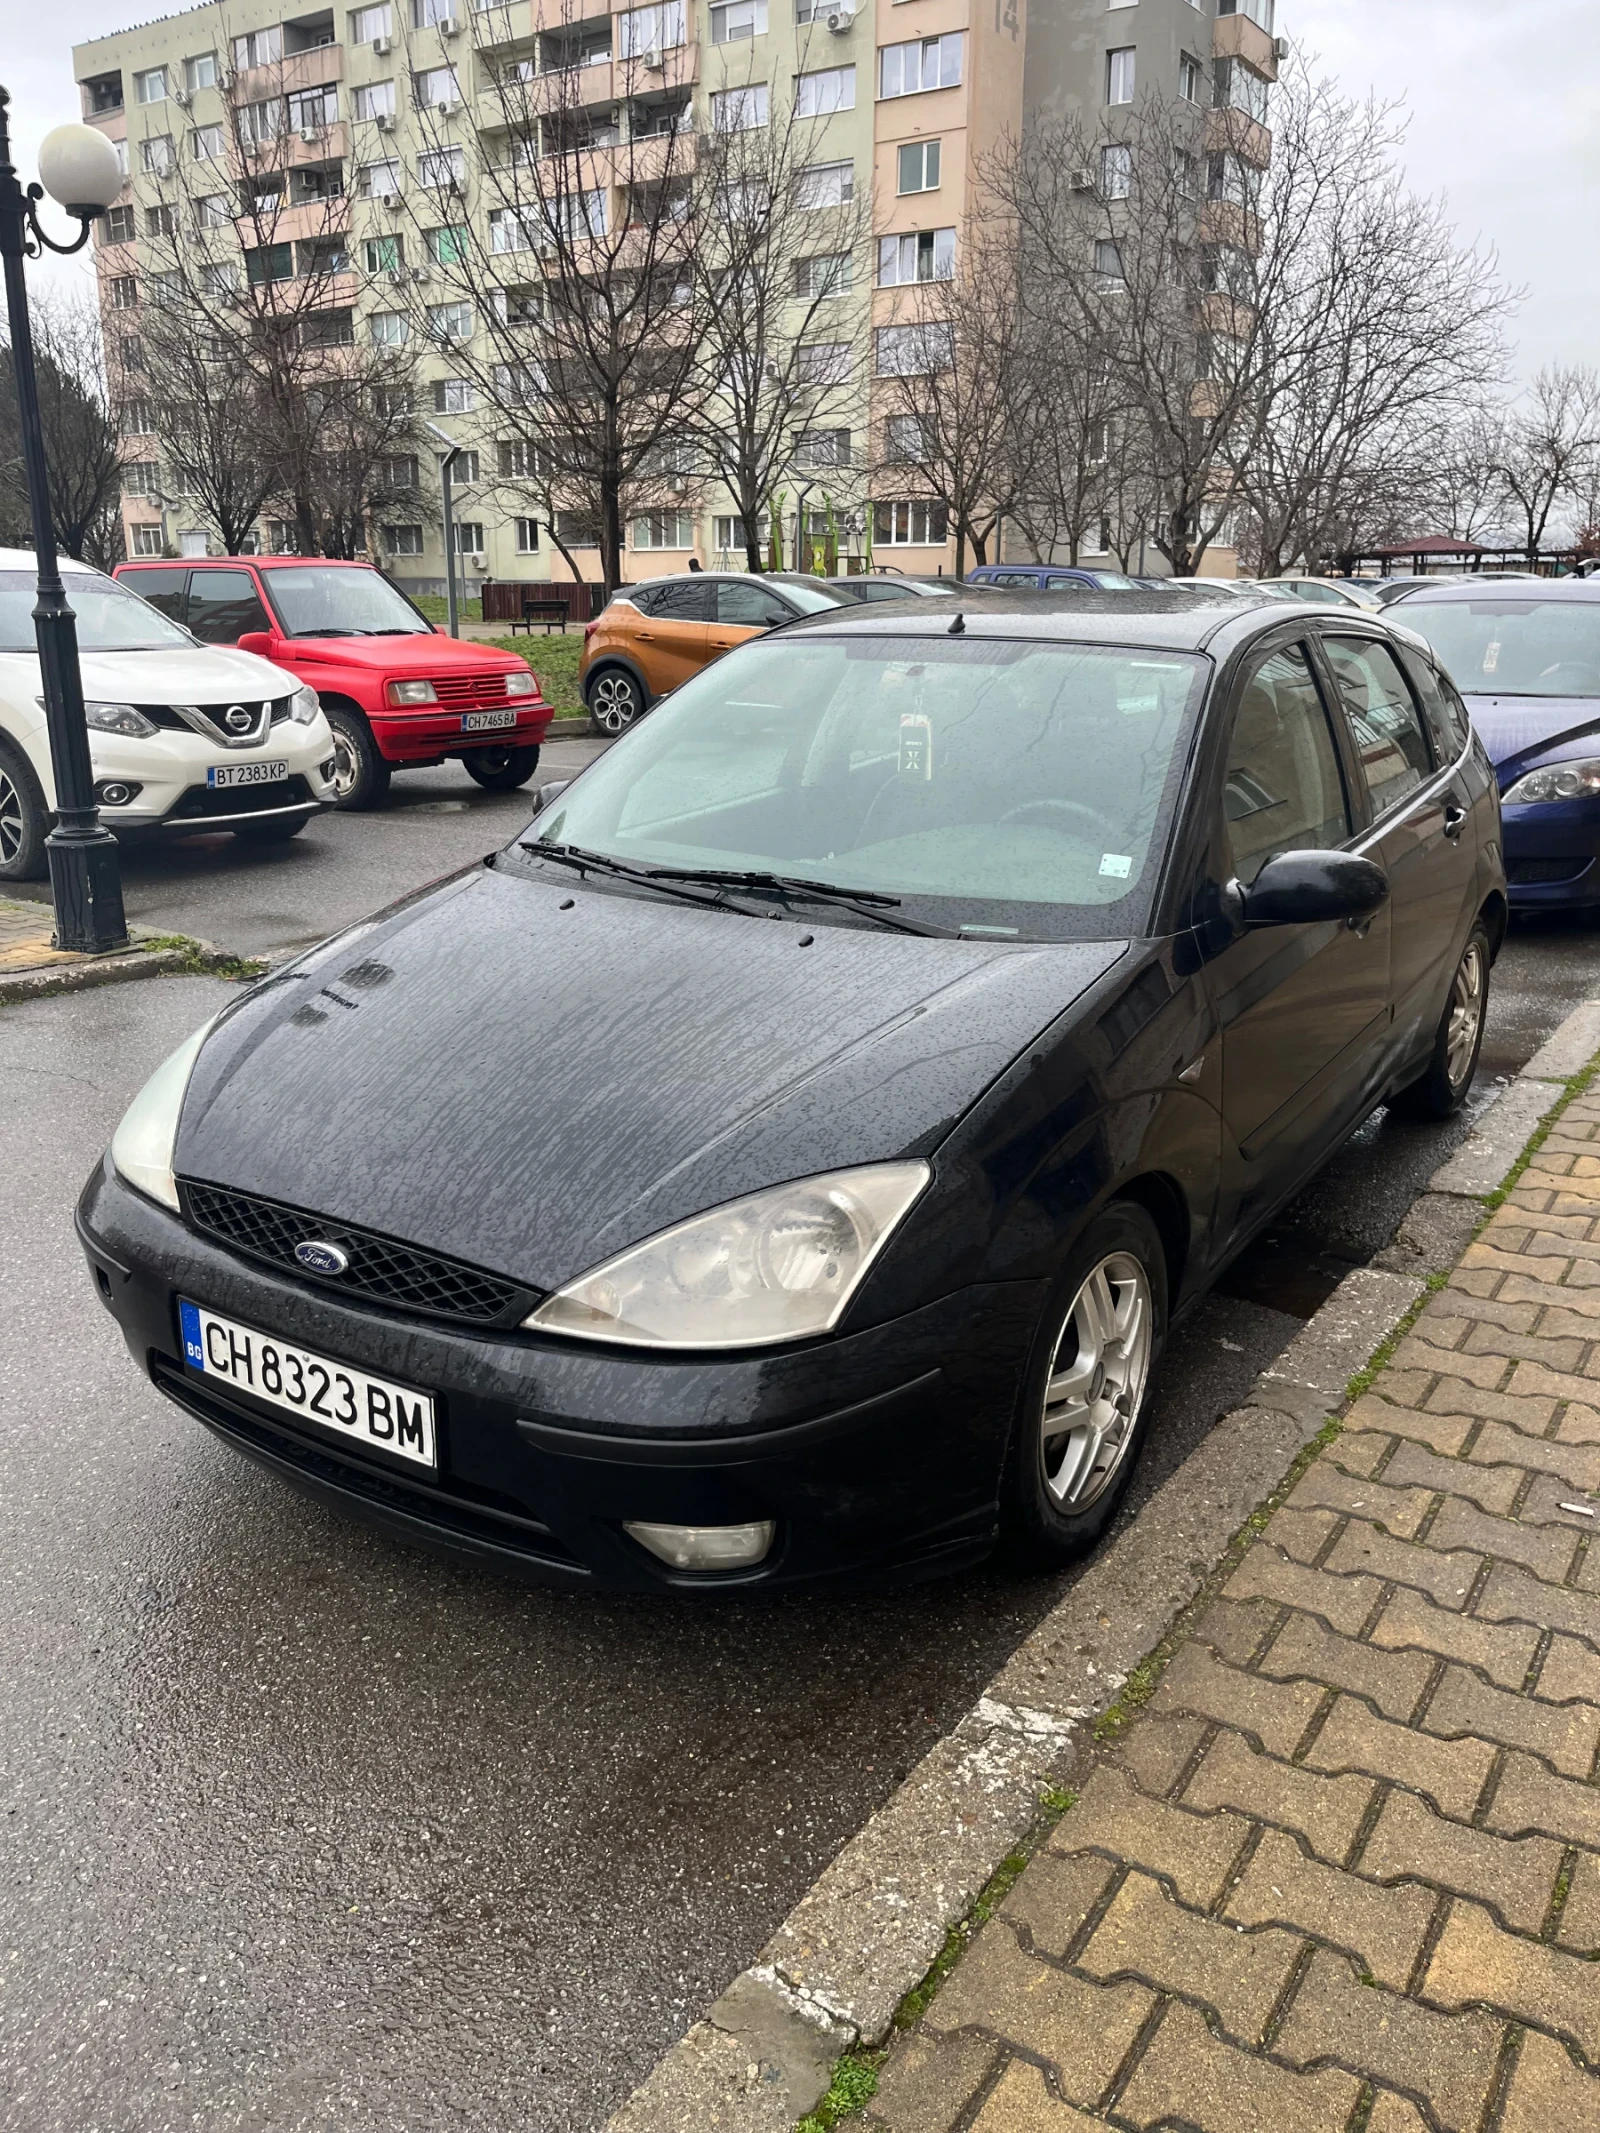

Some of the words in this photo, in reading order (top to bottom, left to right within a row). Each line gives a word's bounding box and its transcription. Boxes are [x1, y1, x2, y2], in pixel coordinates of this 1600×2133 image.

[468, 715, 481, 728] CH
[482, 714, 503, 728] 7465
[504, 712, 515, 726] BA
[217, 768, 235, 785] BT
[237, 765, 269, 783] 2383
[270, 763, 286, 779] KP
[304, 1247, 332, 1269] Ford
[187, 1341, 203, 1360] BG
[206, 1321, 254, 1386] CH
[261, 1344, 358, 1426] 8323
[366, 1383, 425, 1455] BM
